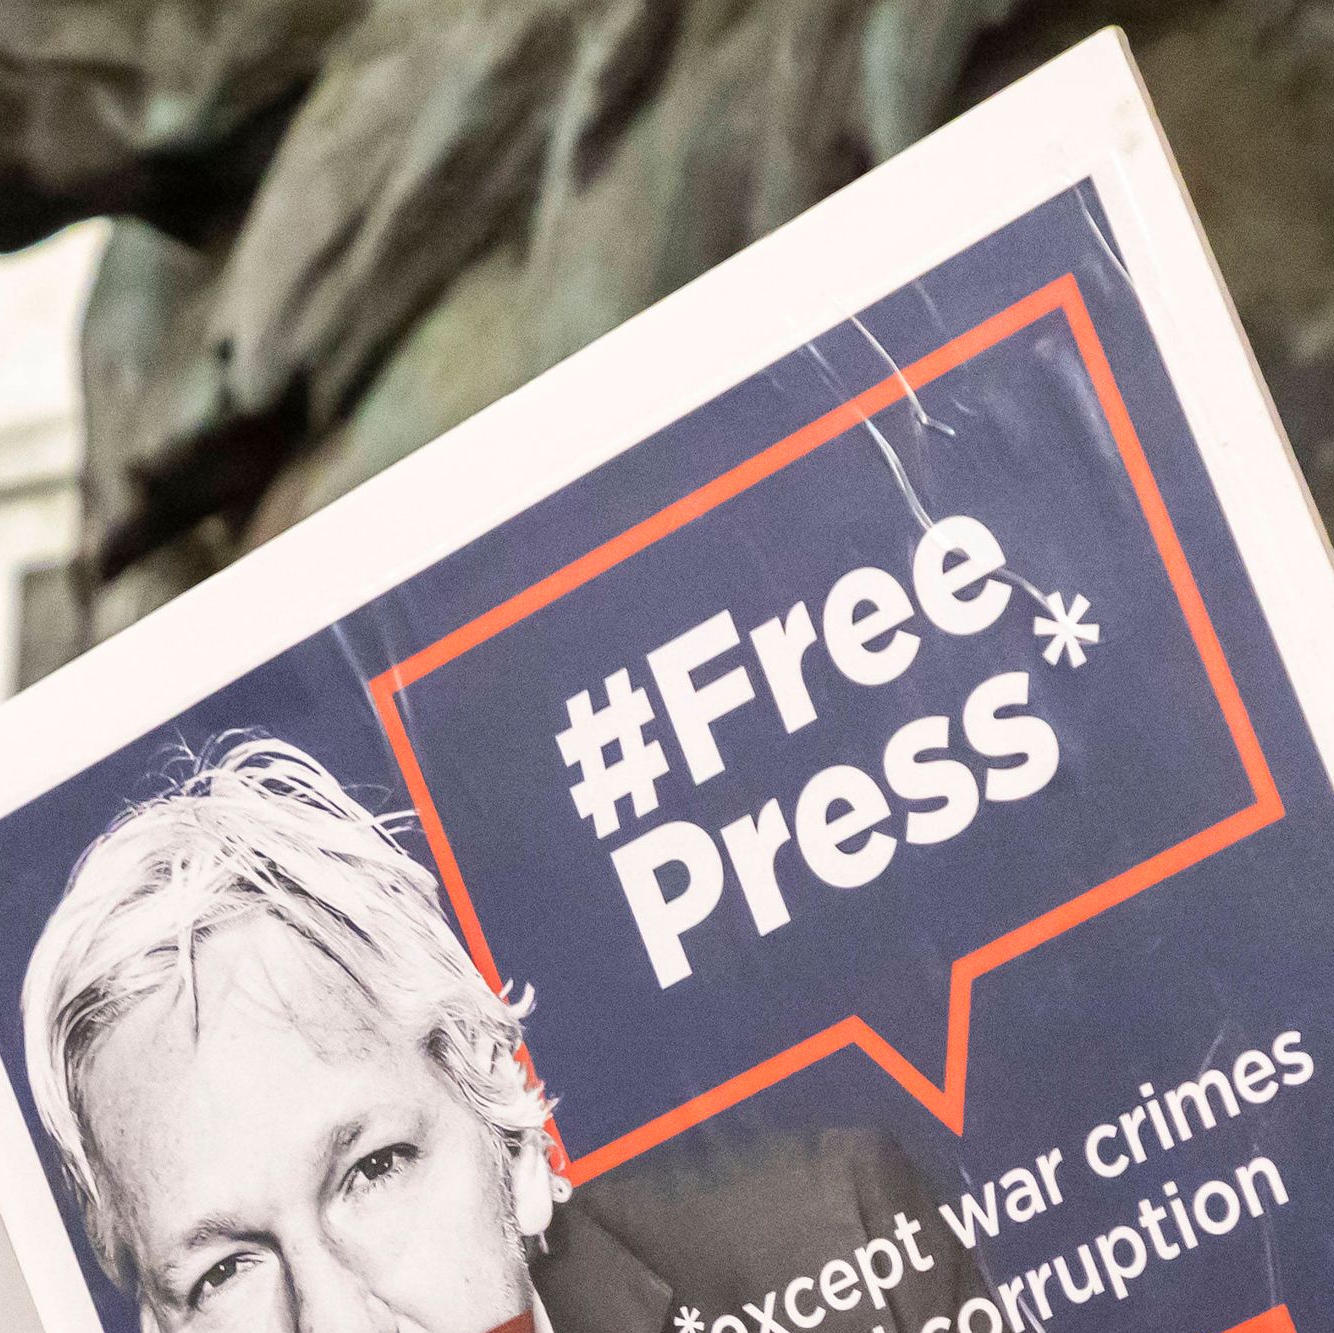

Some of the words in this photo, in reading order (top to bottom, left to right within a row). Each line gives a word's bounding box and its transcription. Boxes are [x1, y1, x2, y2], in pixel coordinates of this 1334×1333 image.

[554, 515, 1012, 839] #Free
[940, 1147, 1063, 1251] war
[1085, 1030, 1315, 1179] crimes
